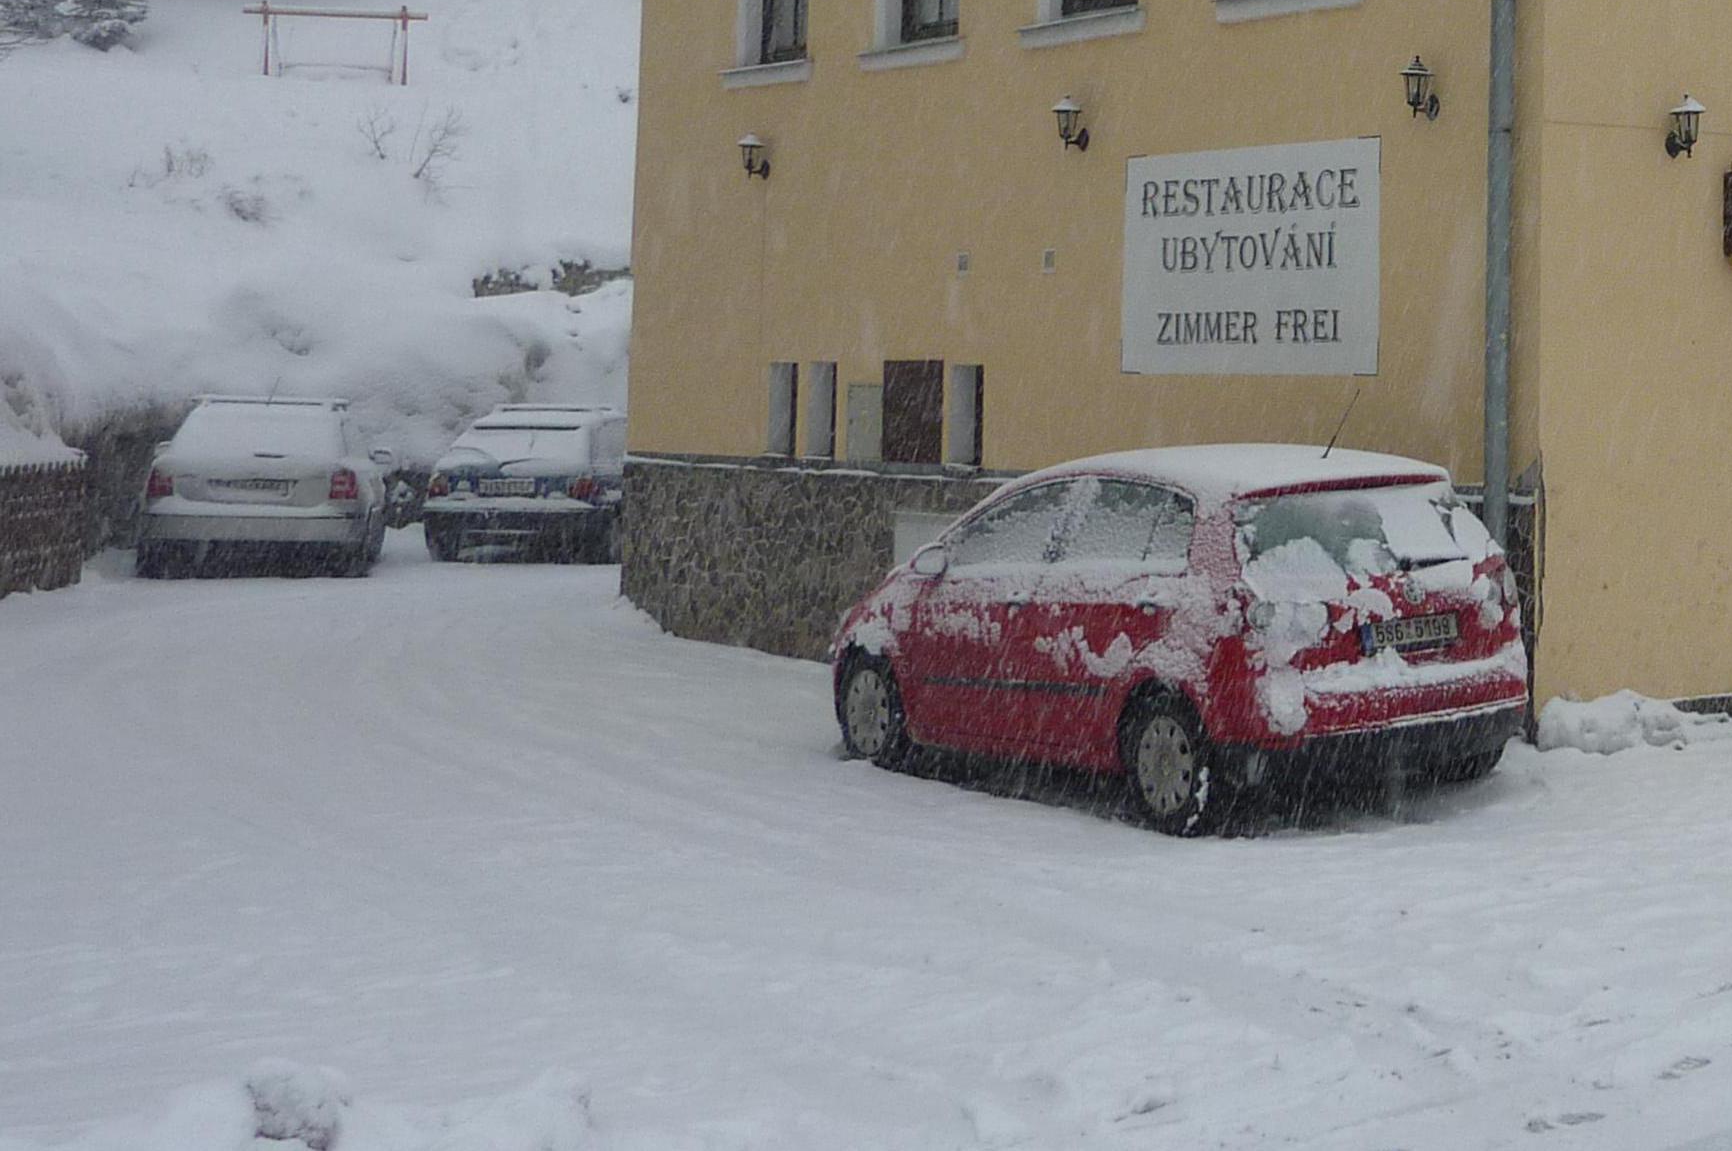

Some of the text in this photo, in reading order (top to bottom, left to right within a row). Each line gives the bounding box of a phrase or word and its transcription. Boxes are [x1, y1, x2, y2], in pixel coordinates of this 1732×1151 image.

[1141, 167, 1361, 218] RESTAURACE
[1161, 221, 1338, 273] UBYTOVÁNÍ
[1157, 309, 1342, 345] ZIMMER FREI
